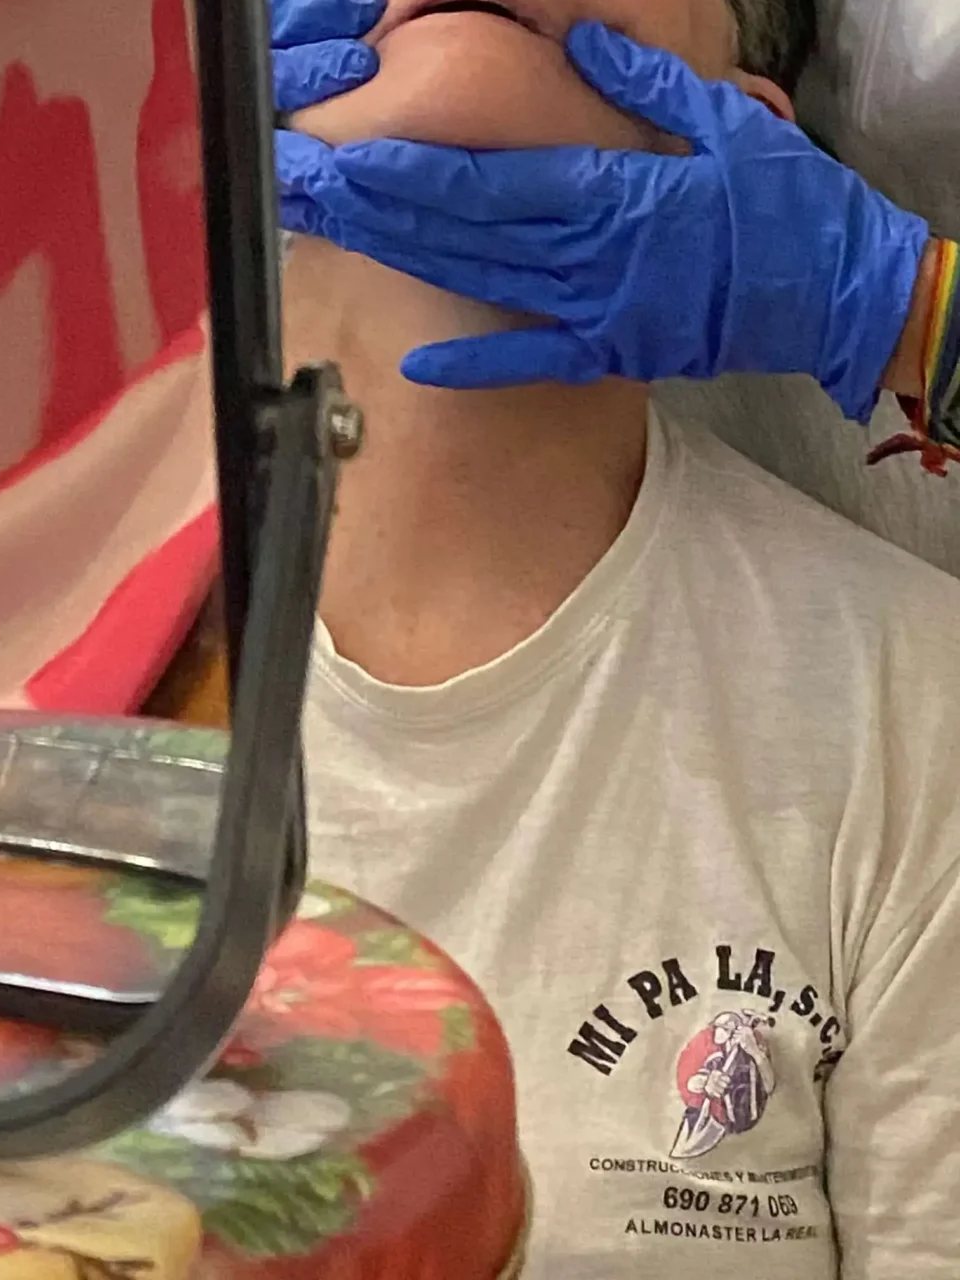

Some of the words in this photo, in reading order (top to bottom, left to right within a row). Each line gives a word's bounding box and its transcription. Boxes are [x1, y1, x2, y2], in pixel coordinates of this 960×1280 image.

[567, 1004, 638, 1076] MI
[627, 957, 699, 1019] PA
[663, 1186, 710, 1212] 690
[717, 1193, 760, 1218] 871
[624, 1218, 757, 1243] ALMONASTER
[761, 1227, 781, 1242] LA
